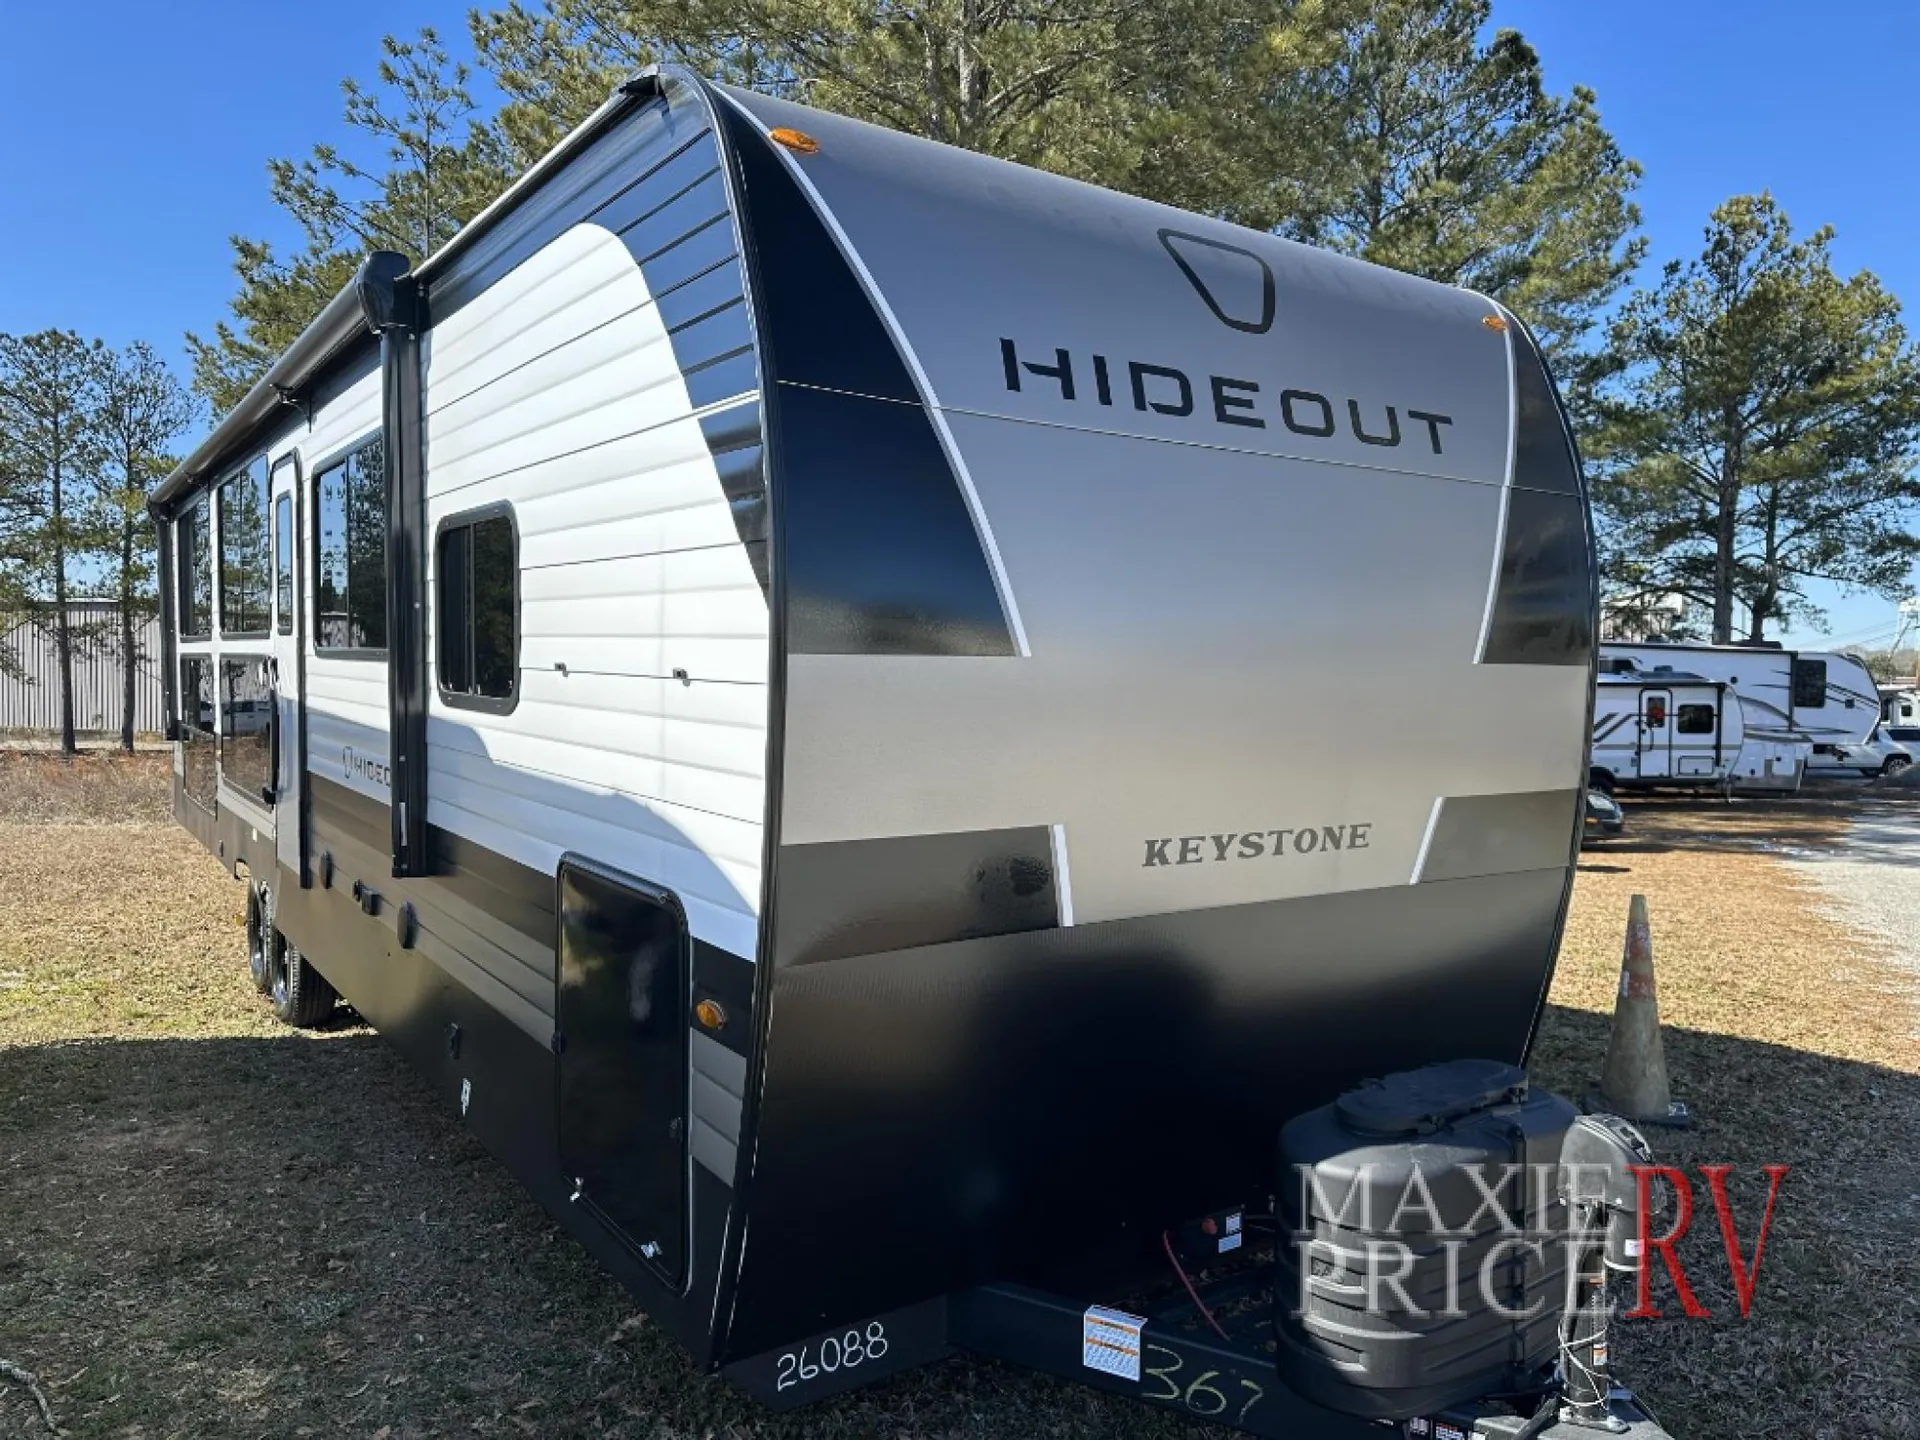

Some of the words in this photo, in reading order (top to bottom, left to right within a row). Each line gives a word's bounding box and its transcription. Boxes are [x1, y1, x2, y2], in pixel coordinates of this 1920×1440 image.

[1000, 337, 1454, 455] HIDEOUT
[1141, 822, 1372, 868] KEYSTONE
[777, 1320, 889, 1393] 26088
[1141, 1343, 1264, 1424] 367
